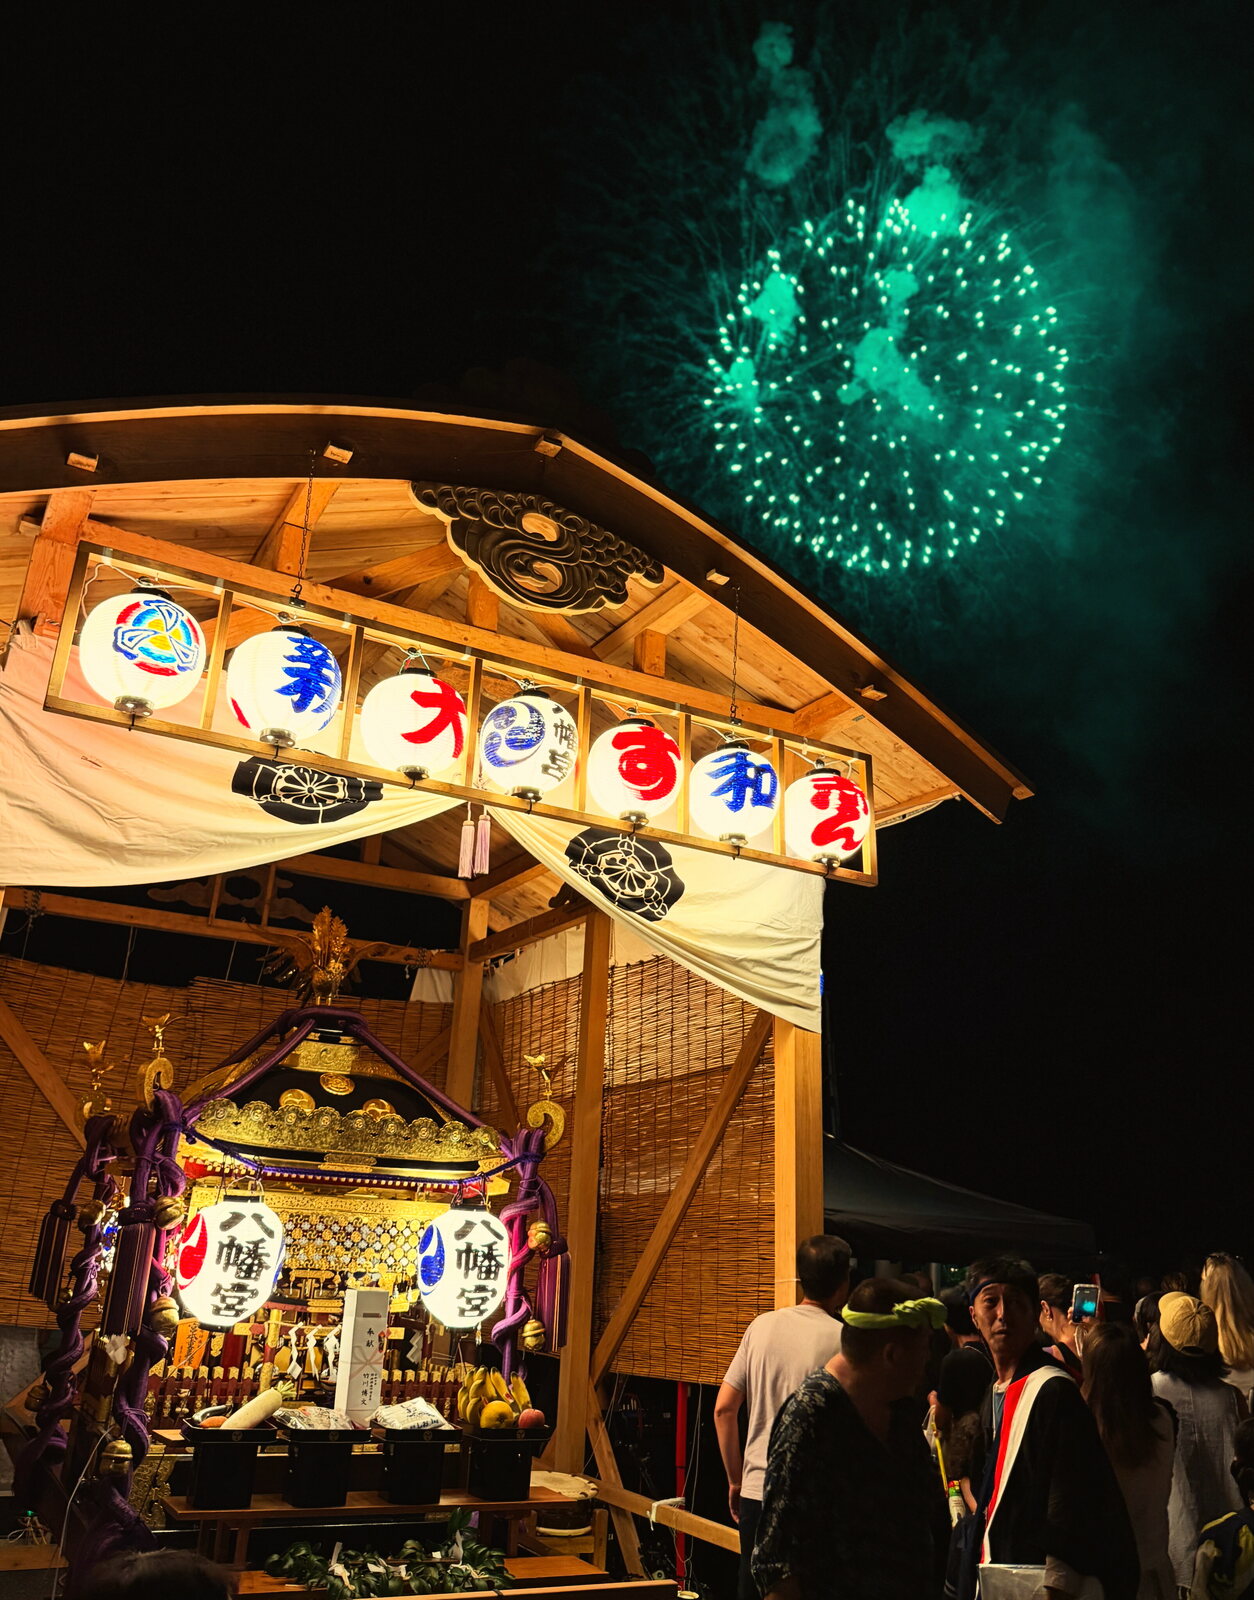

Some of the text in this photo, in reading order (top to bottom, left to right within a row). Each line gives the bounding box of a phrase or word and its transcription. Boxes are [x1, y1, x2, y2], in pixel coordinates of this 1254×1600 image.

[401, 678, 467, 758] 大
[704, 751, 778, 813] 和
[210, 1211, 275, 1318] 八幡宮
[454, 1219, 504, 1317] 八幡宮
